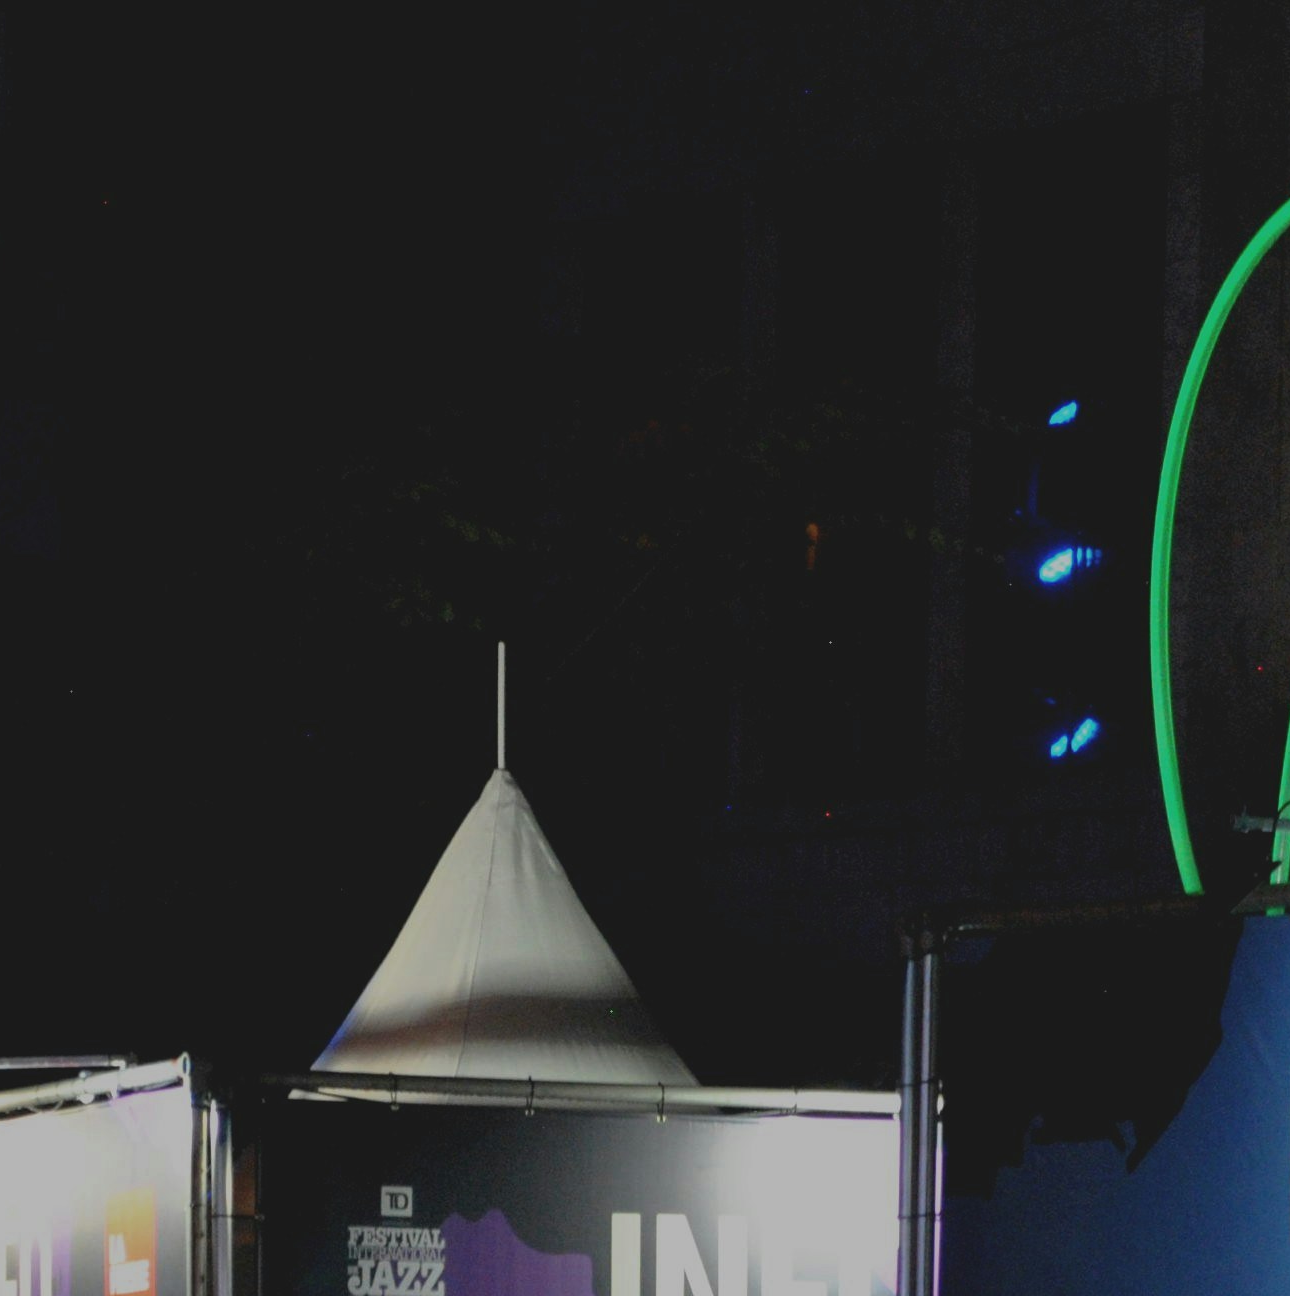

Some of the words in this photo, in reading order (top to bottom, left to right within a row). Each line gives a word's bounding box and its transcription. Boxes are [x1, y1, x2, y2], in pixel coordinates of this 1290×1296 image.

[385, 1192, 408, 1211] TD
[348, 1226, 445, 1249] FESTIVAL
[348, 1246, 445, 1263] INTERNATIONAL
